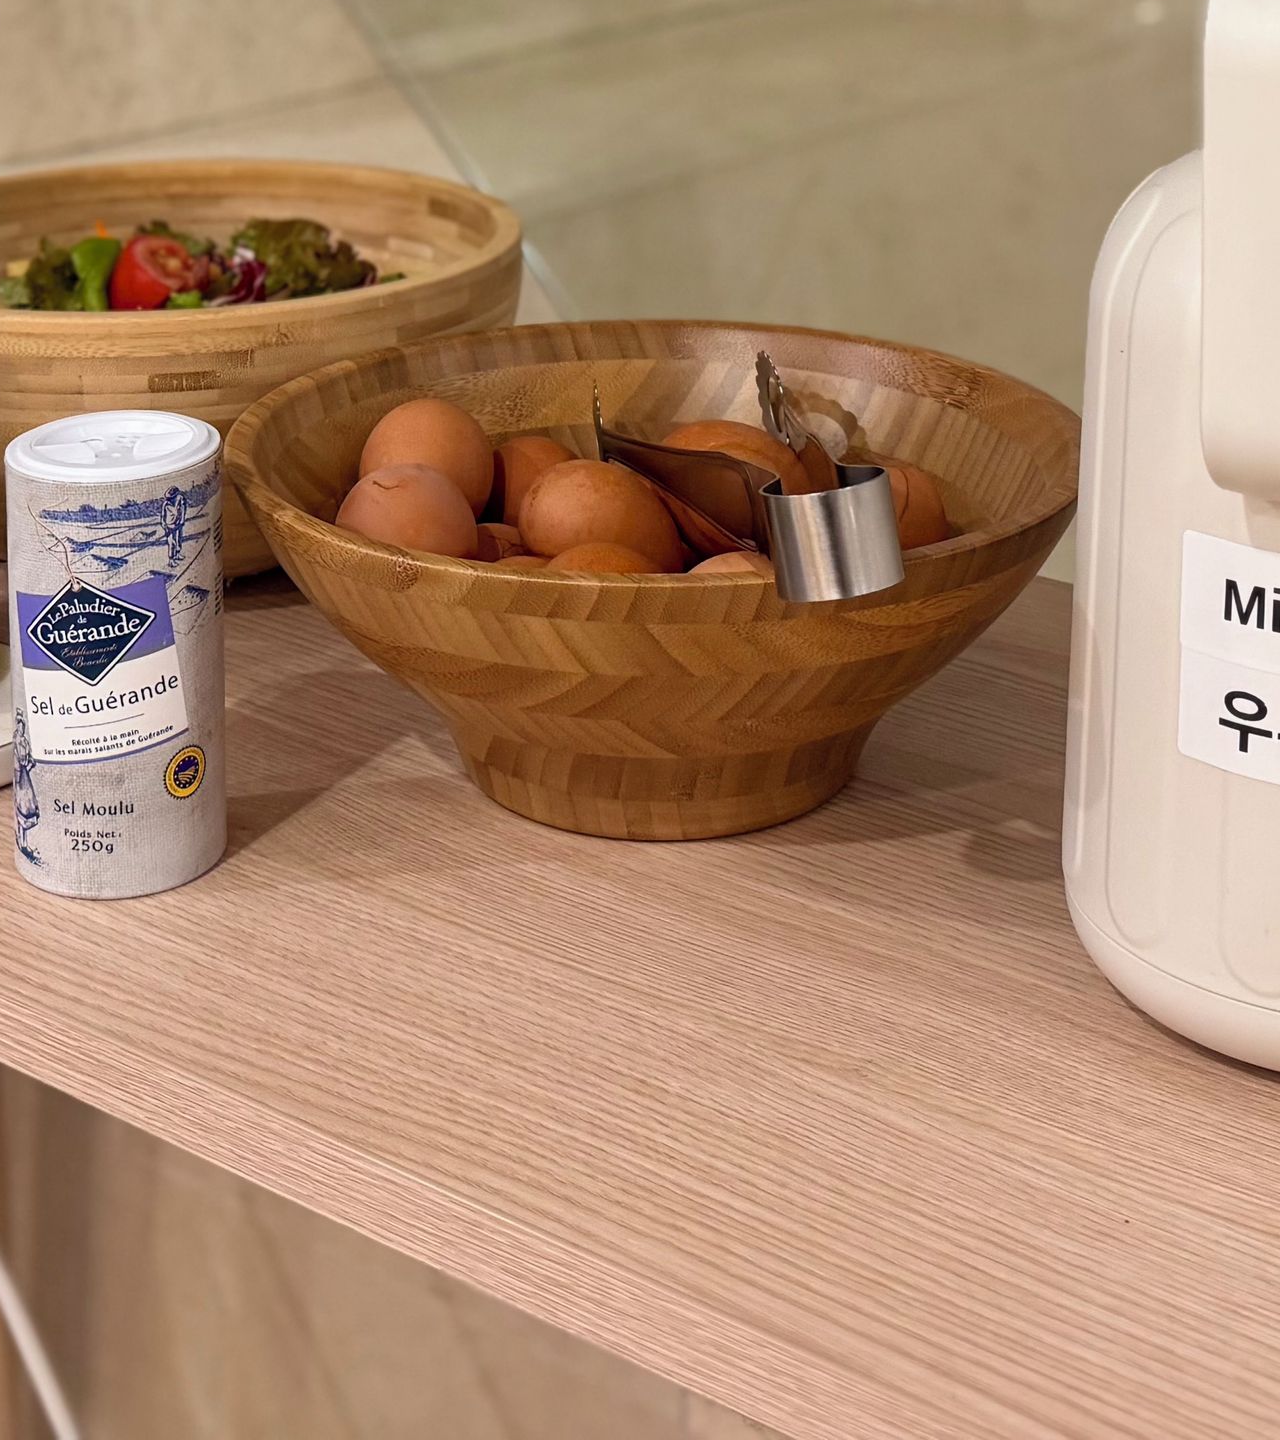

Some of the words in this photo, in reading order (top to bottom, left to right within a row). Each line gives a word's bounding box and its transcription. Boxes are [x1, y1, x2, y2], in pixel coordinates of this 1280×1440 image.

[48, 611, 61, 624] Le
[57, 598, 120, 616] Paludier
[77, 616, 87, 624] de
[37, 613, 142, 644] Guérande
[31, 695, 54, 715] Sel
[58, 704, 73, 715] de
[75, 674, 179, 714] Guérande
[68, 747, 92, 755] marais
[95, 743, 124, 753] salants
[138, 725, 174, 742] Guérande
[71, 737, 101, 746] Récolté
[110, 733, 118, 741] la
[120, 729, 140, 739] main
[53, 798, 75, 814] Sel
[83, 801, 134, 816] Moulu
[64, 828, 92, 838] Poids
[71, 838, 114, 854] 250g
